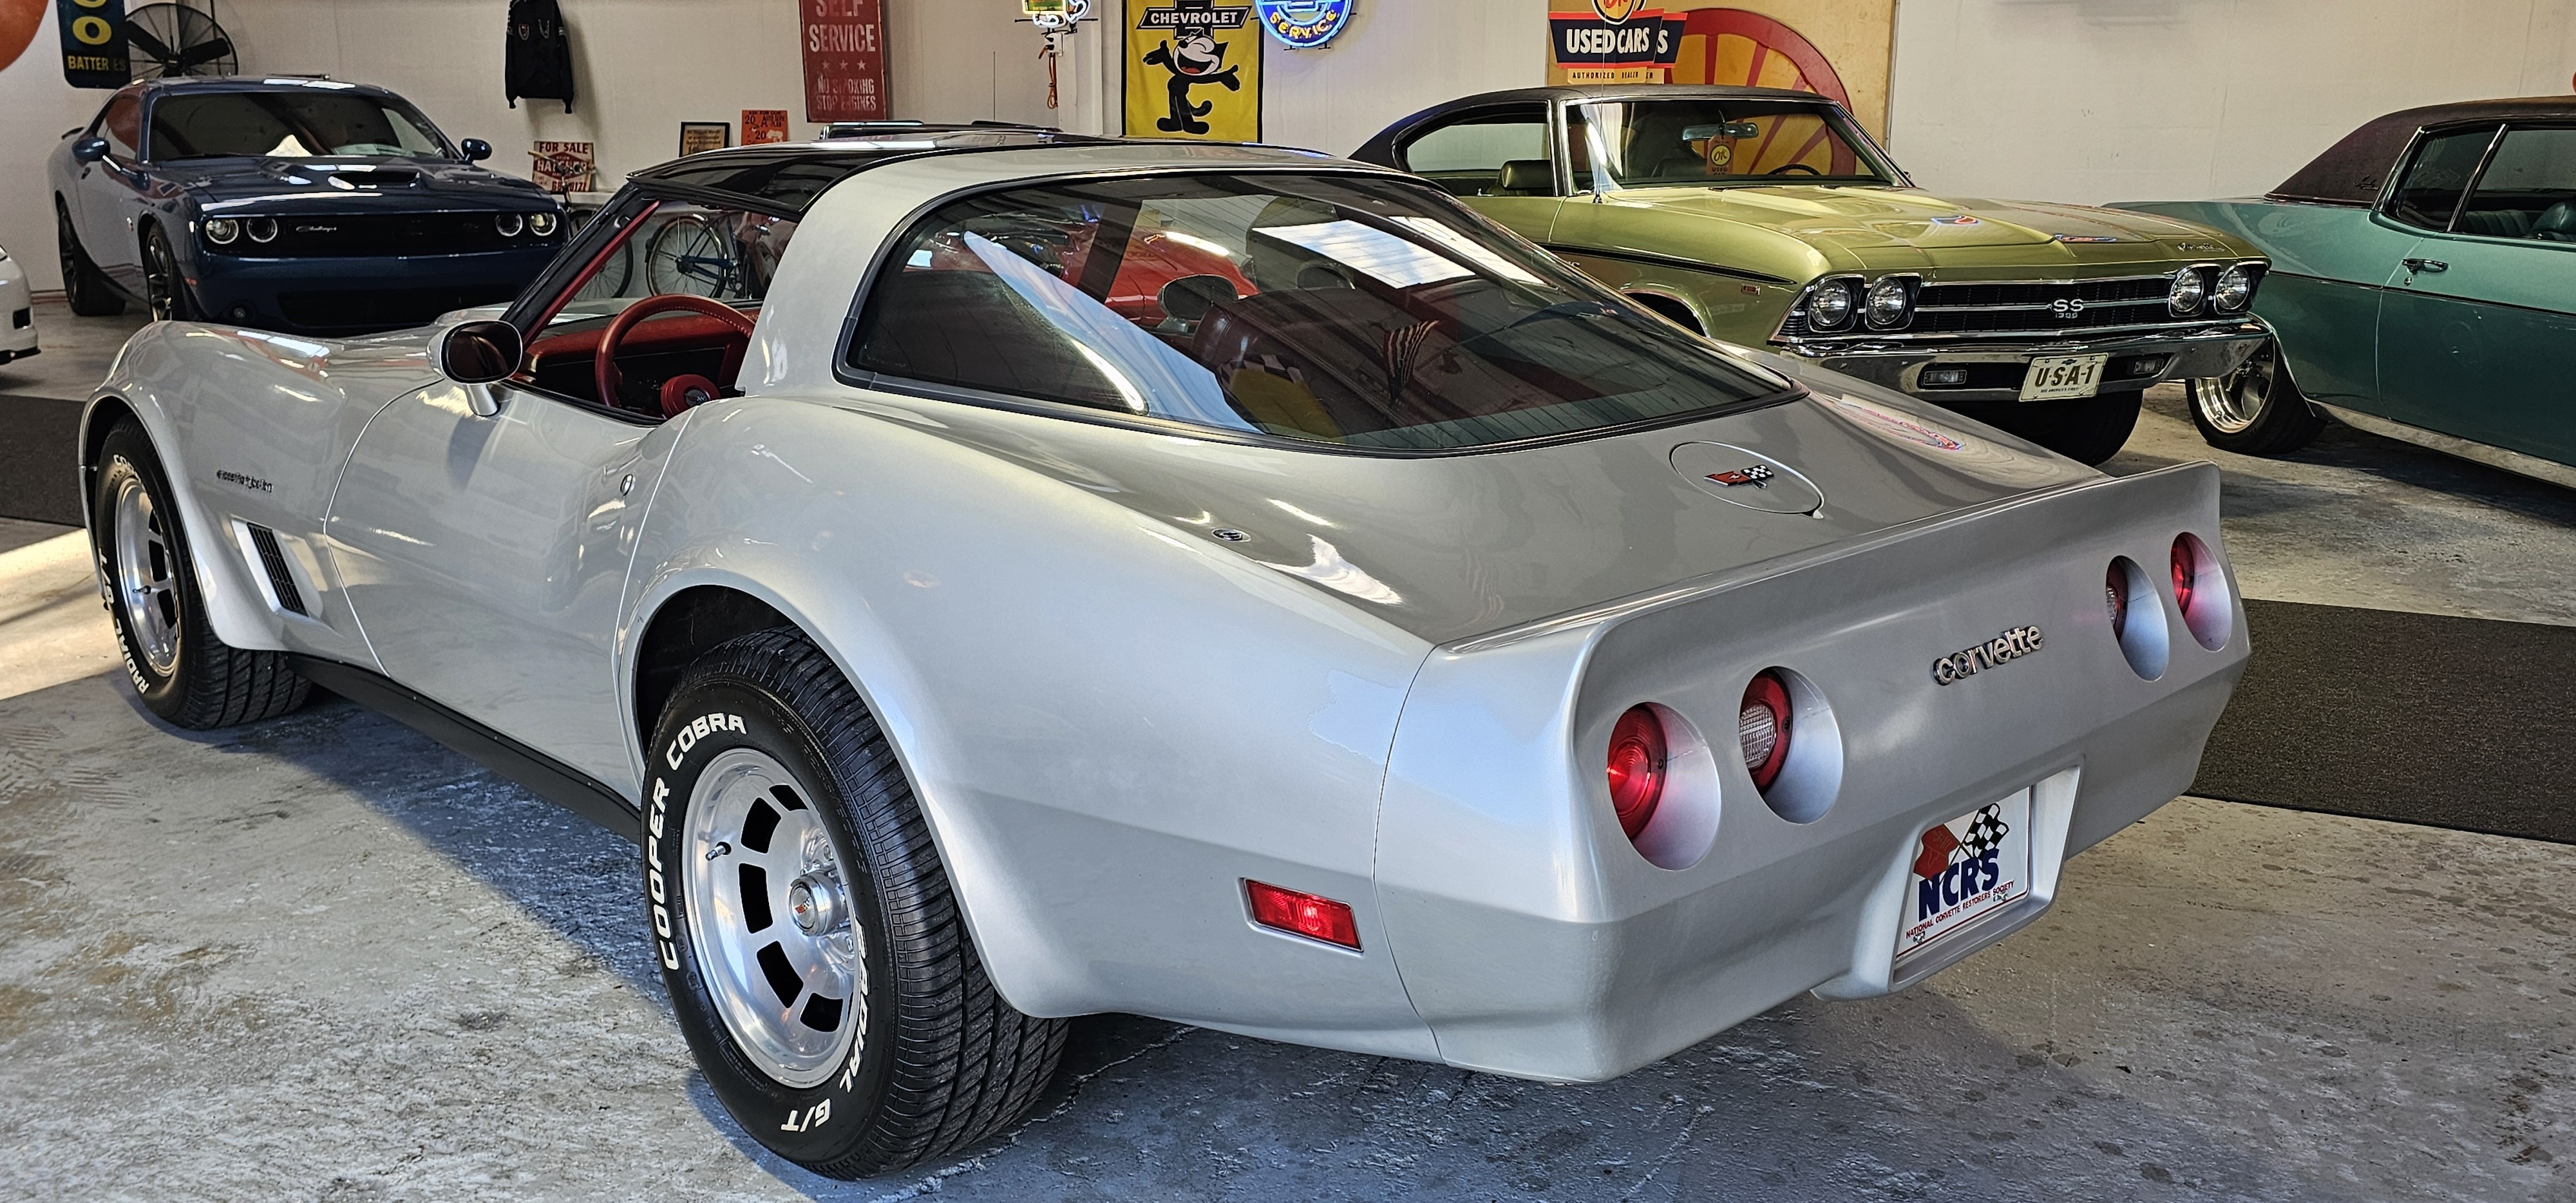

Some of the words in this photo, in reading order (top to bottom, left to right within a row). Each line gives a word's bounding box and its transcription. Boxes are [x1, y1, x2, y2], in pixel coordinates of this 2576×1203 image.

[1151, 12, 1238, 24] CHEVROLET
[1269, 10, 1338, 39] SERVICE
[809, 24, 876, 52] SERVICE
[1566, 29, 1616, 53] USED
[1617, 27, 1650, 53] CARS
[817, 77, 829, 94] NO
[817, 96, 837, 110] STOP
[744, 115, 756, 124] 20
[539, 142, 559, 153] FOR
[564, 142, 588, 155] SALE
[755, 131, 766, 140] 20
[1714, 148, 1727, 161] OK
[2053, 298, 2084, 312] SS
[1933, 626, 2043, 686] corvette
[666, 712, 747, 772] COBRA
[648, 777, 679, 971] COOPER
[1918, 848, 2000, 922] NCRS
[1906, 919, 1934, 939] NATIONAL
[1935, 905, 1960, 924] CORVETTE
[1962, 891, 1991, 911] RESTORERS
[1993, 880, 2014, 896] SOCIETY
[839, 917, 869, 1094] RADIAL
[781, 1098, 831, 1133] G/T
